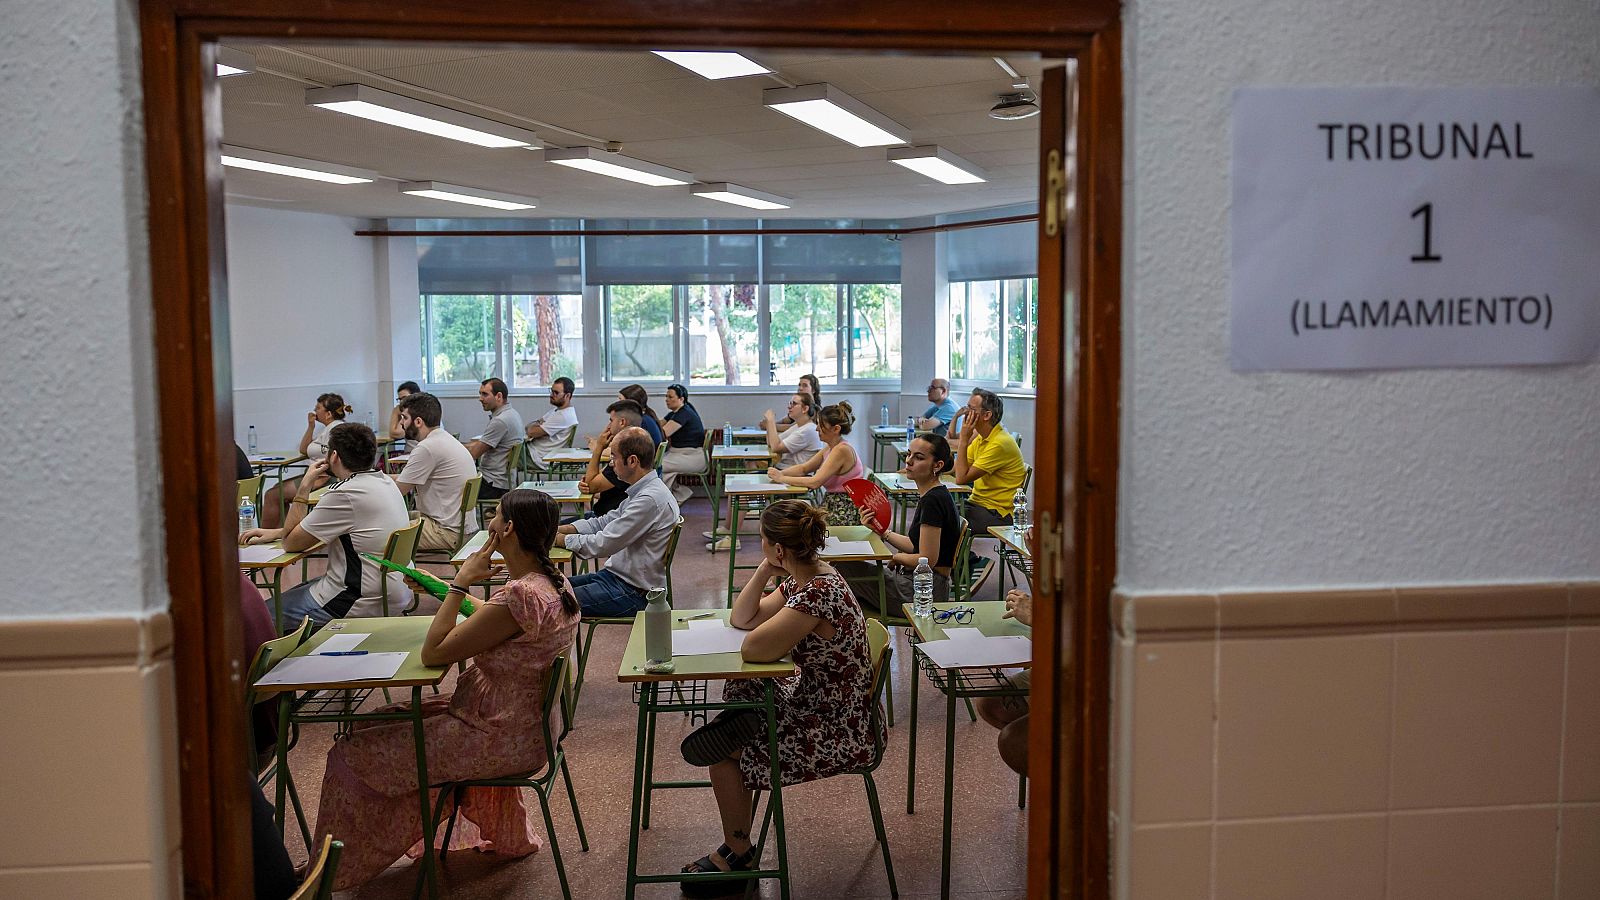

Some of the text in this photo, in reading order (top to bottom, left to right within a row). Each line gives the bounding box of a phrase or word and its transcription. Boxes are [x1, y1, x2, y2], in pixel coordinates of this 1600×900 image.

[1317, 122, 1534, 161] TRIBUNAL
[1410, 202, 1442, 263] 1
[1291, 294, 1553, 336] (LLAMAMIENTO)
